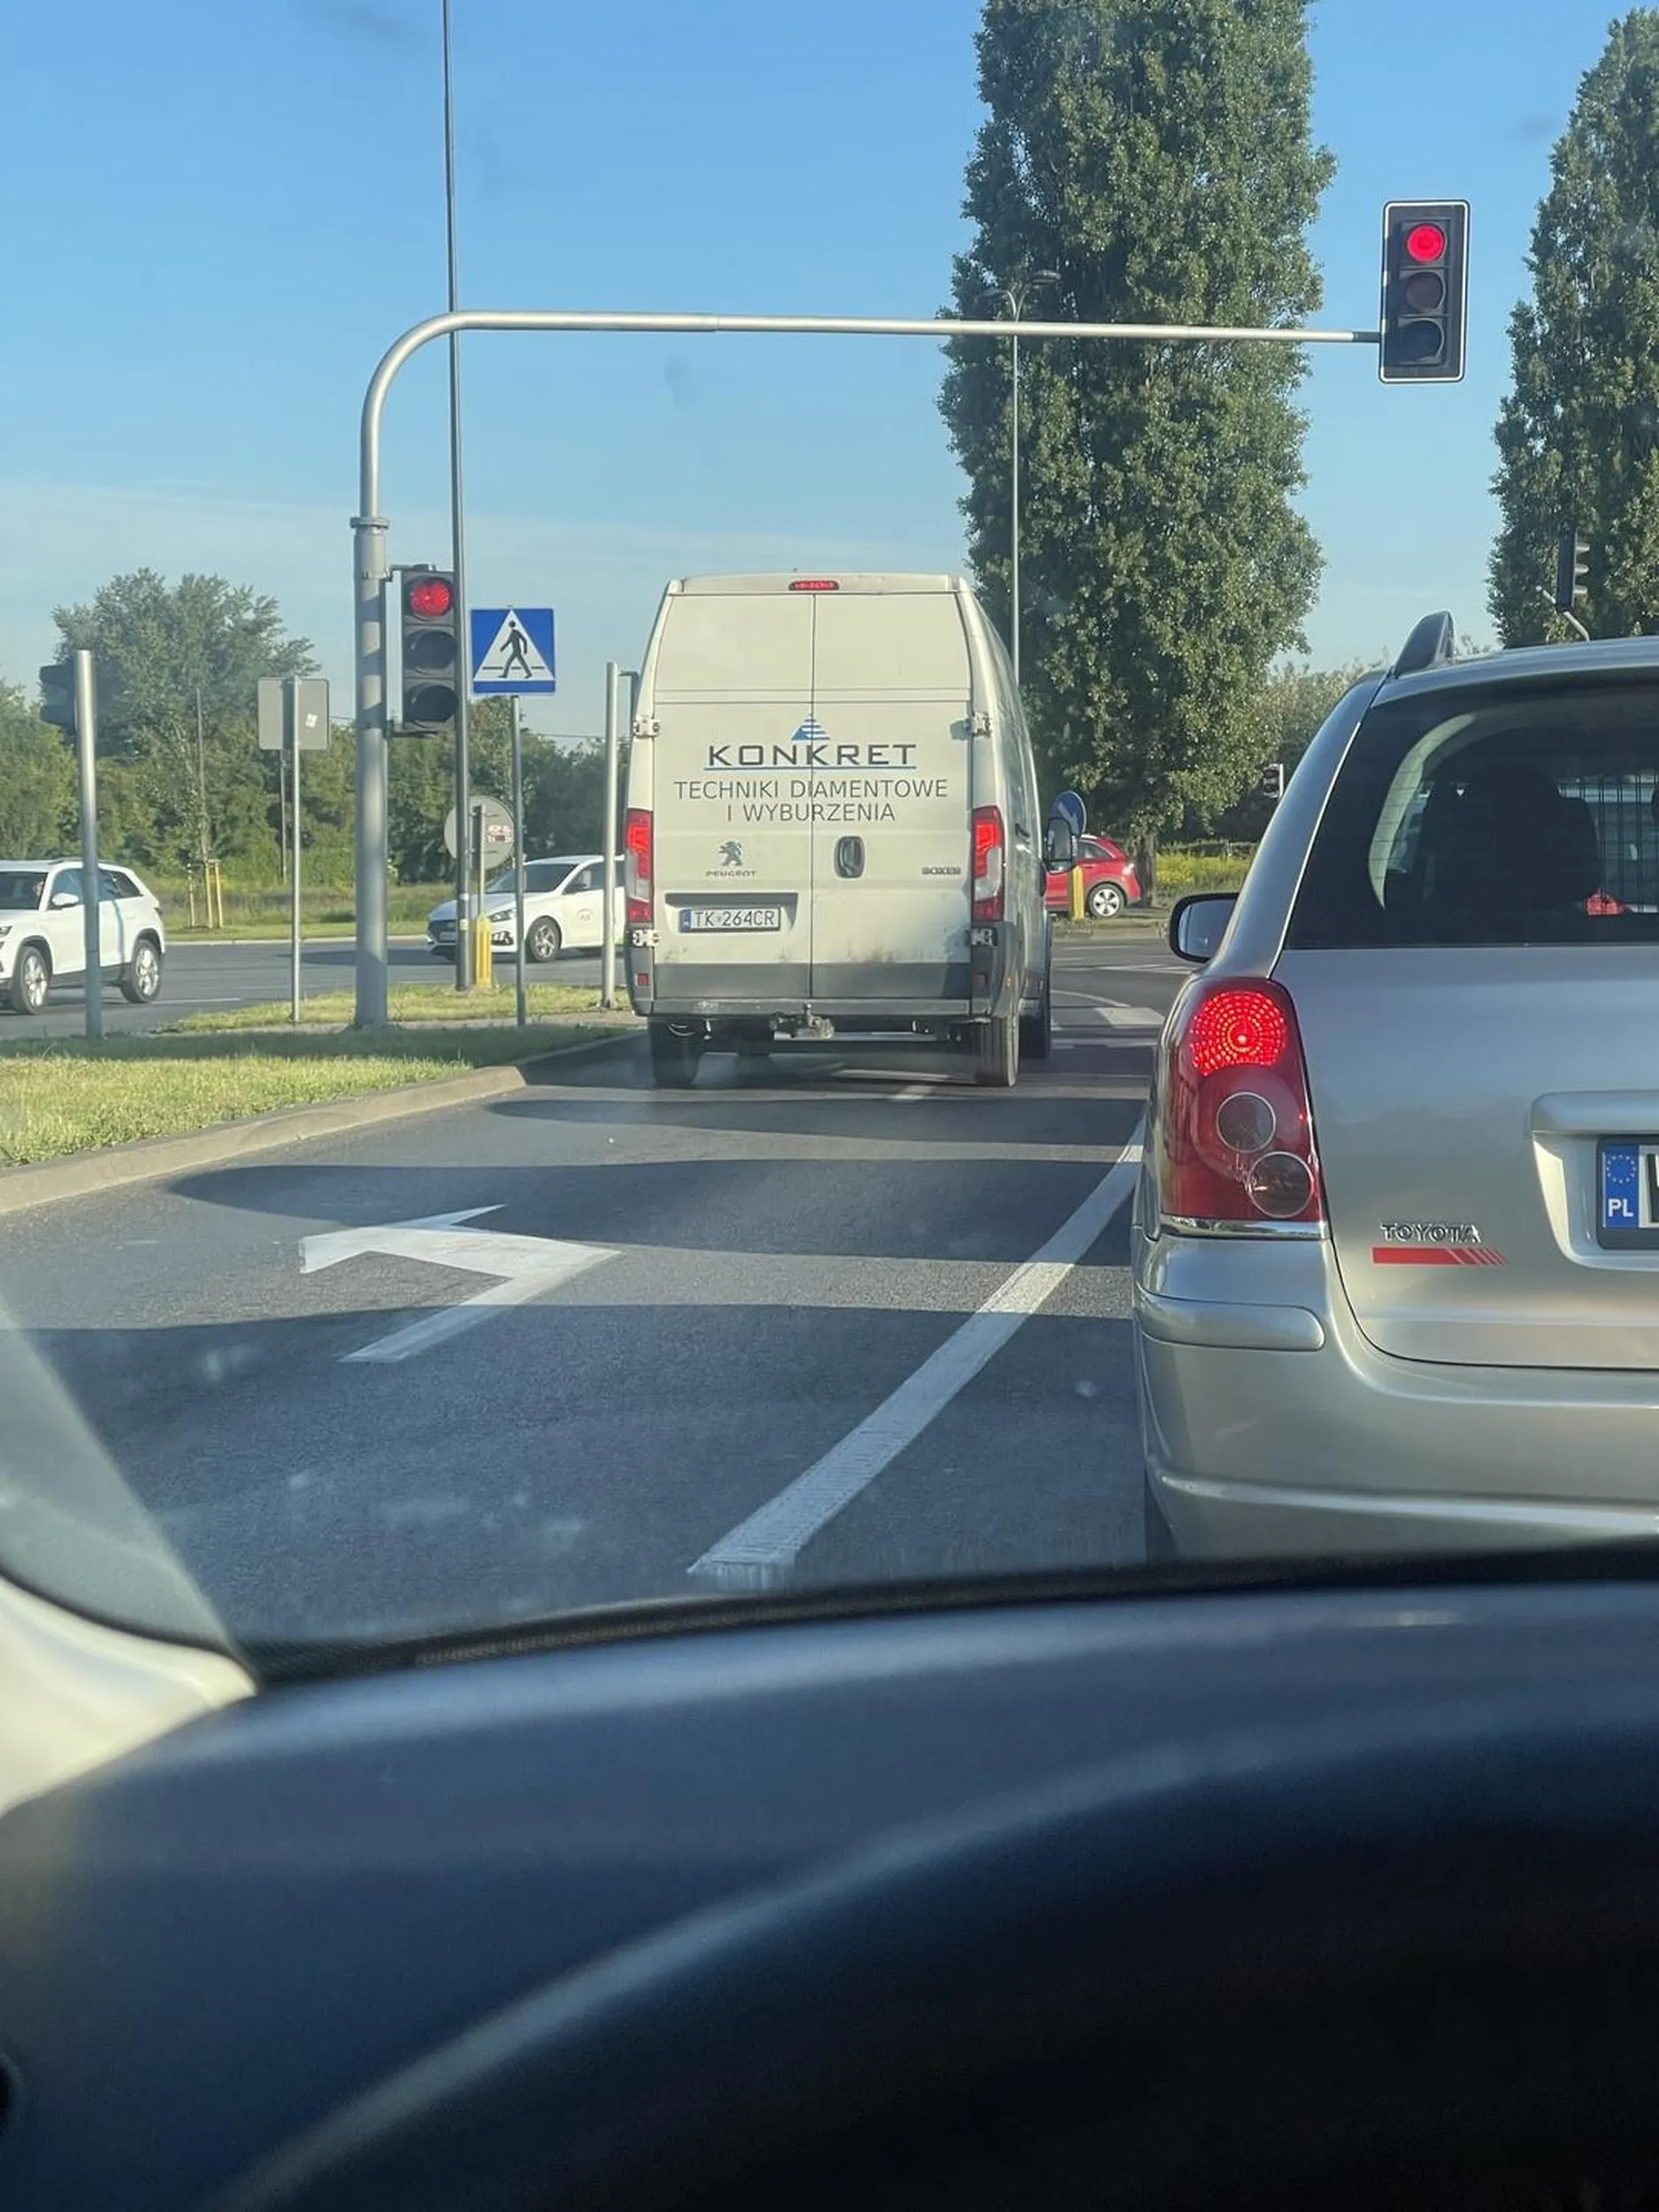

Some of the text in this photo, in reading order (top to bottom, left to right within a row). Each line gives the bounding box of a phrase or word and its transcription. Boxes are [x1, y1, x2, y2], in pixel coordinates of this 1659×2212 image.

[709, 744, 917, 766] KONKRET
[674, 779, 948, 800] TECHNIKI DIAMENTOWE
[726, 803, 895, 822] I WYBURZENIA
[695, 910, 775, 927] TK 264CR
[1608, 1198, 1634, 1217] PL
[1380, 1222, 1481, 1243] TOYOTA
